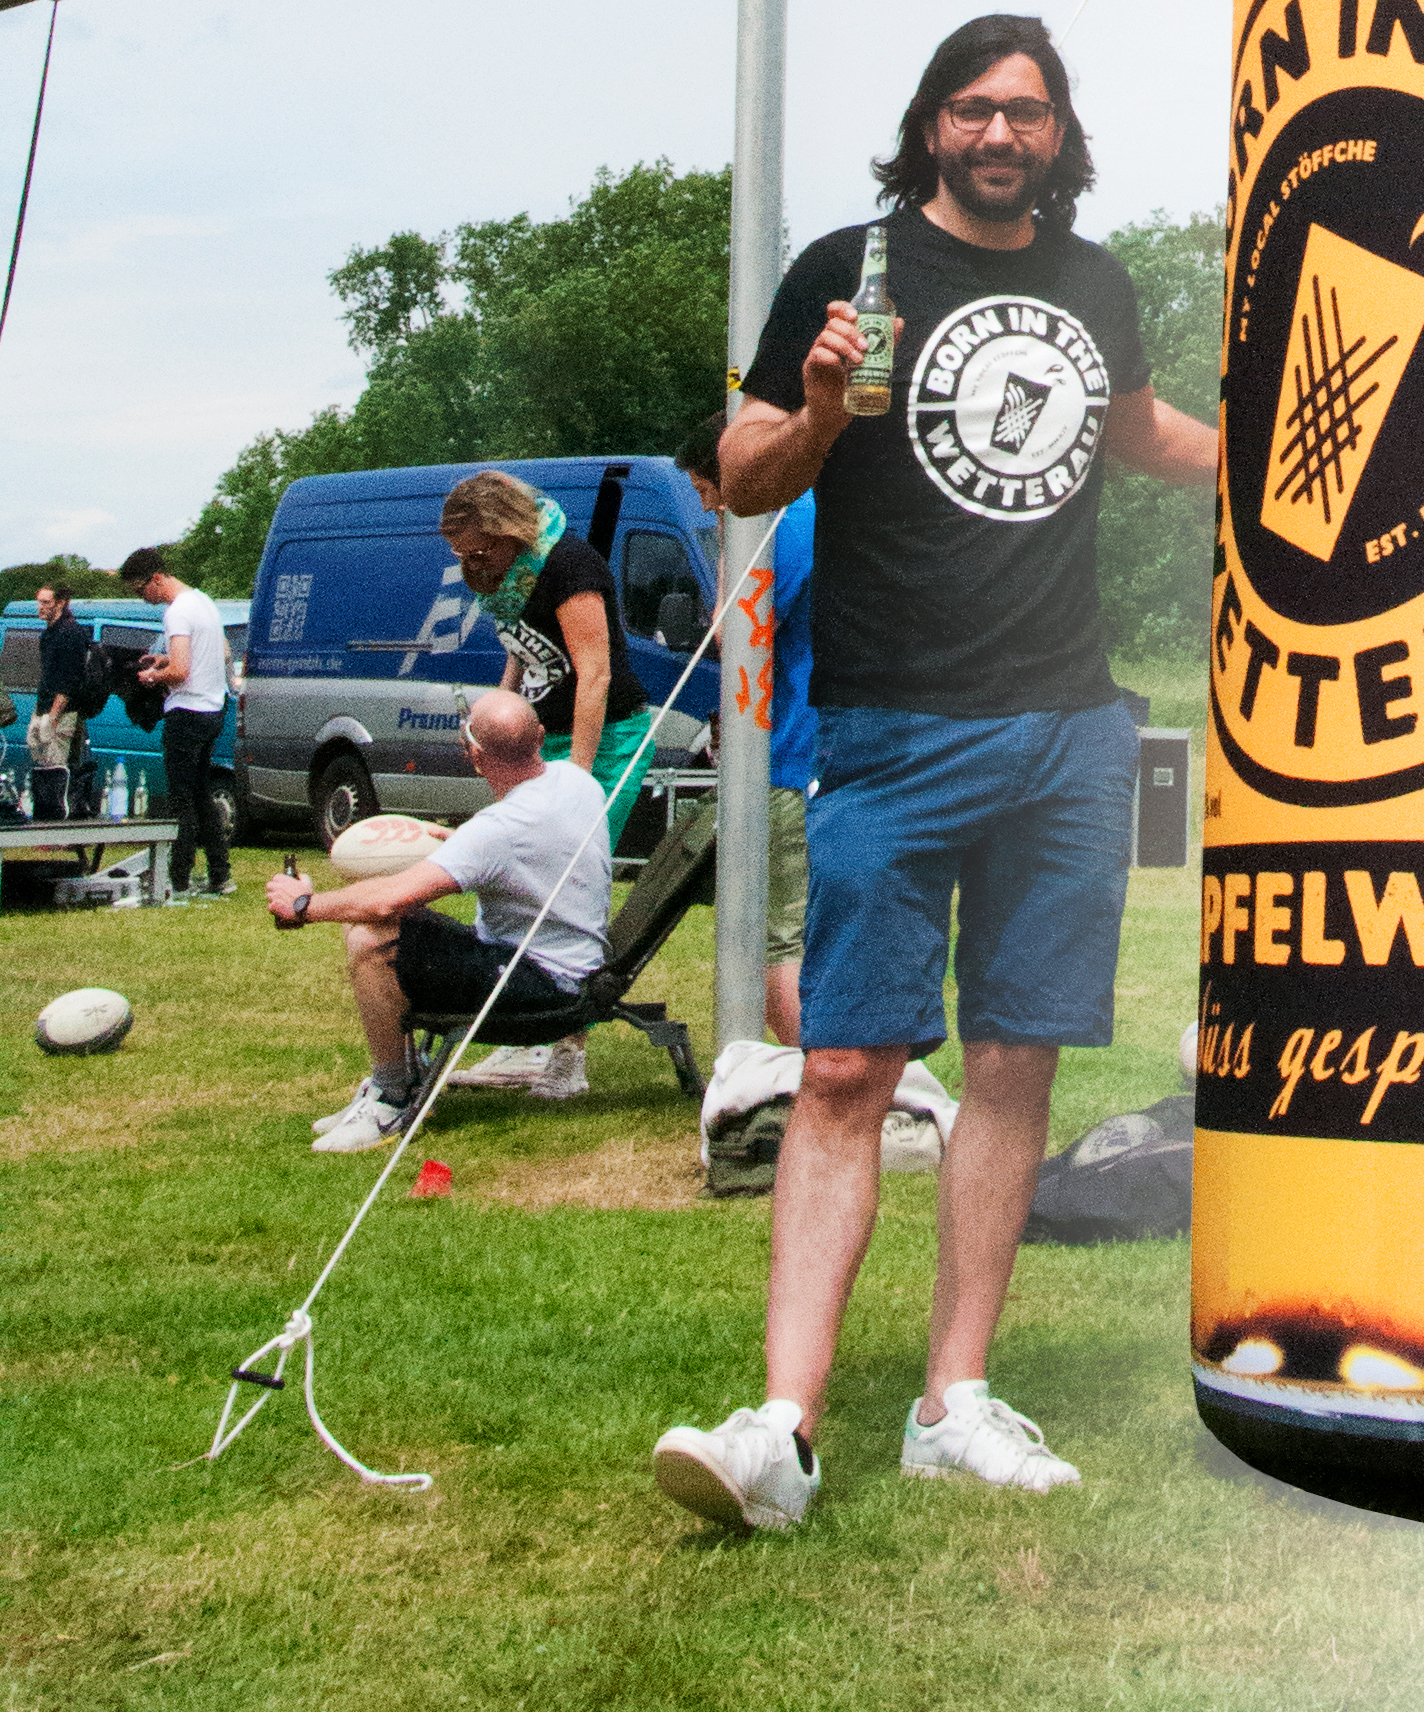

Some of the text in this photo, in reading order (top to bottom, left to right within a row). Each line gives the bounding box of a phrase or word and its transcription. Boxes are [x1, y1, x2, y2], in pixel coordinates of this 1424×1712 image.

[1247, 200, 1280, 287] LOCAL
[1281, 139, 1377, 200] STÖFFCHE
[926, 309, 1003, 396] BORN
[1008, 307, 1047, 336] IN
[1055, 321, 1103, 391] THE
[926, 415, 1098, 507] WETTERAU
[1365, 522, 1419, 564] EST.
